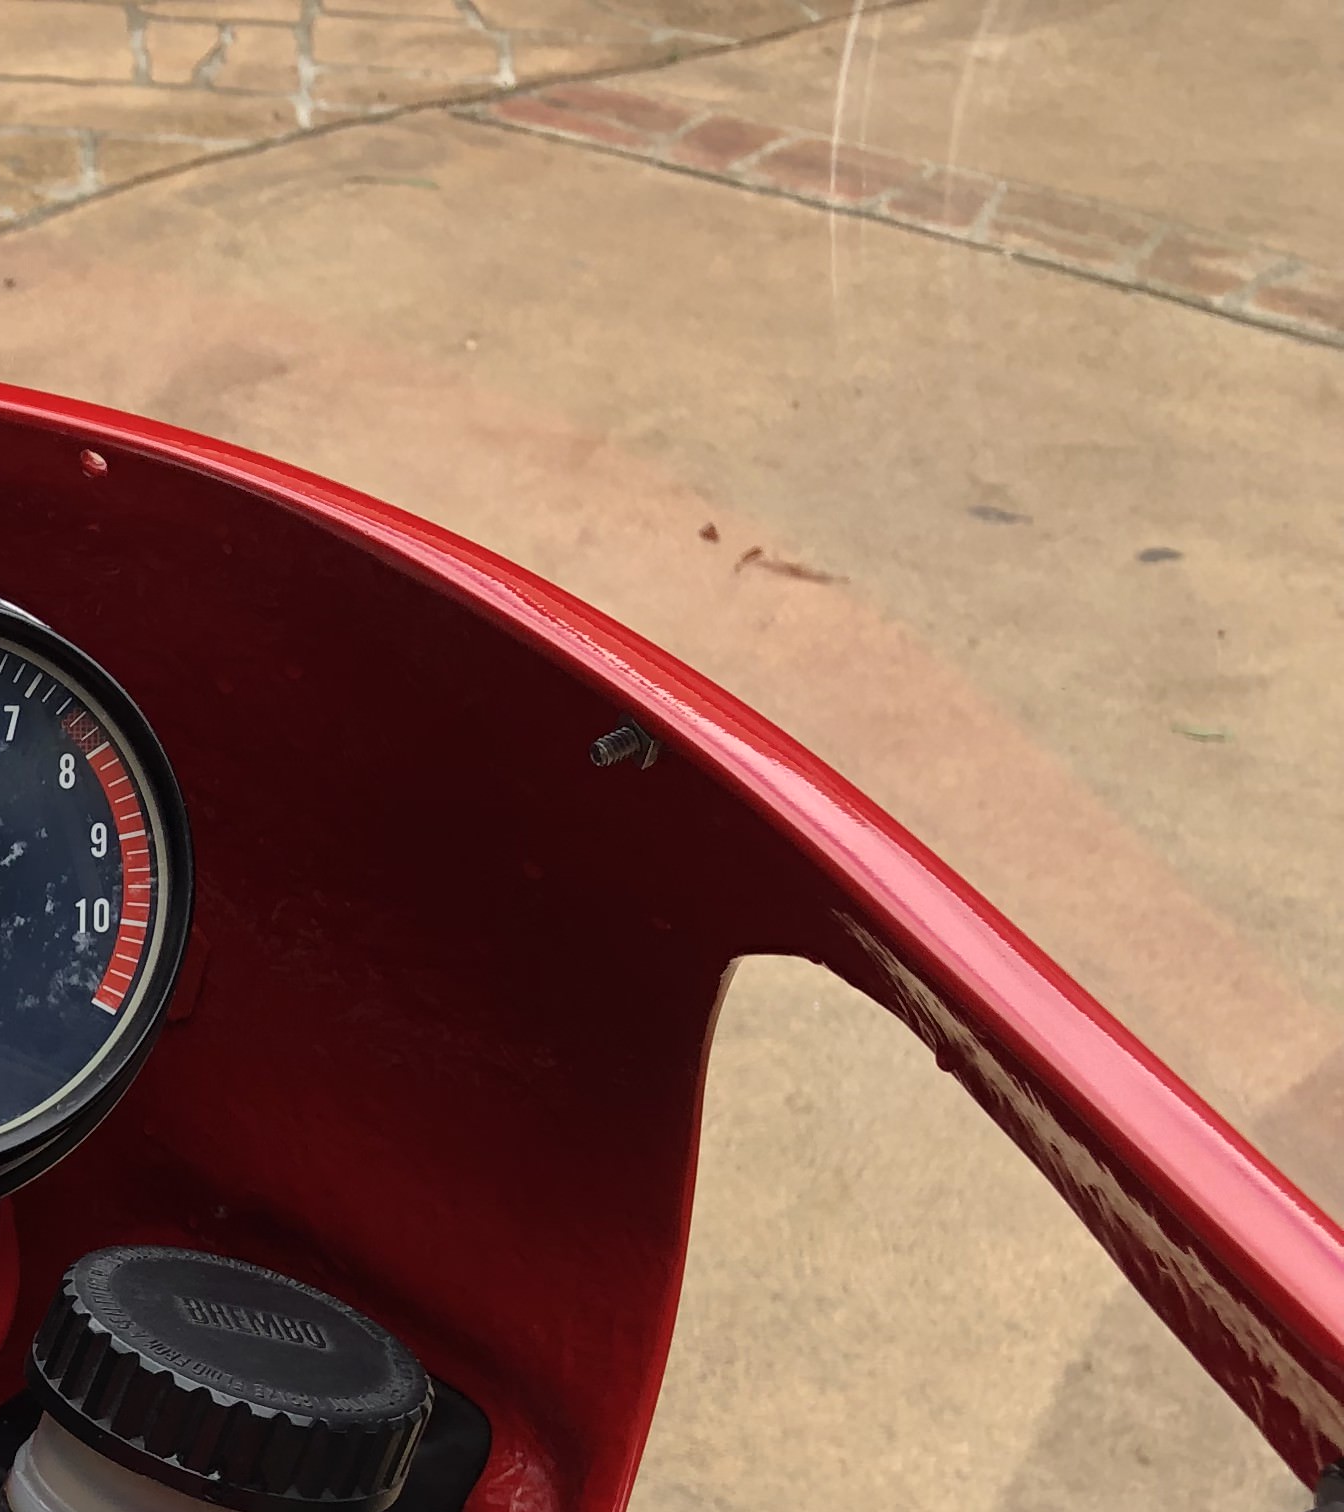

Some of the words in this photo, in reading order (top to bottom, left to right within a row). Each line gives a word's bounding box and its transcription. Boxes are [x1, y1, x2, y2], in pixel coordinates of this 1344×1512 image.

[3, 705, 20, 741] 7
[58, 753, 76, 789] 8
[90, 822, 108, 858] 9
[75, 898, 110, 934] 10
[180, 1297, 328, 1350] BREMBO
